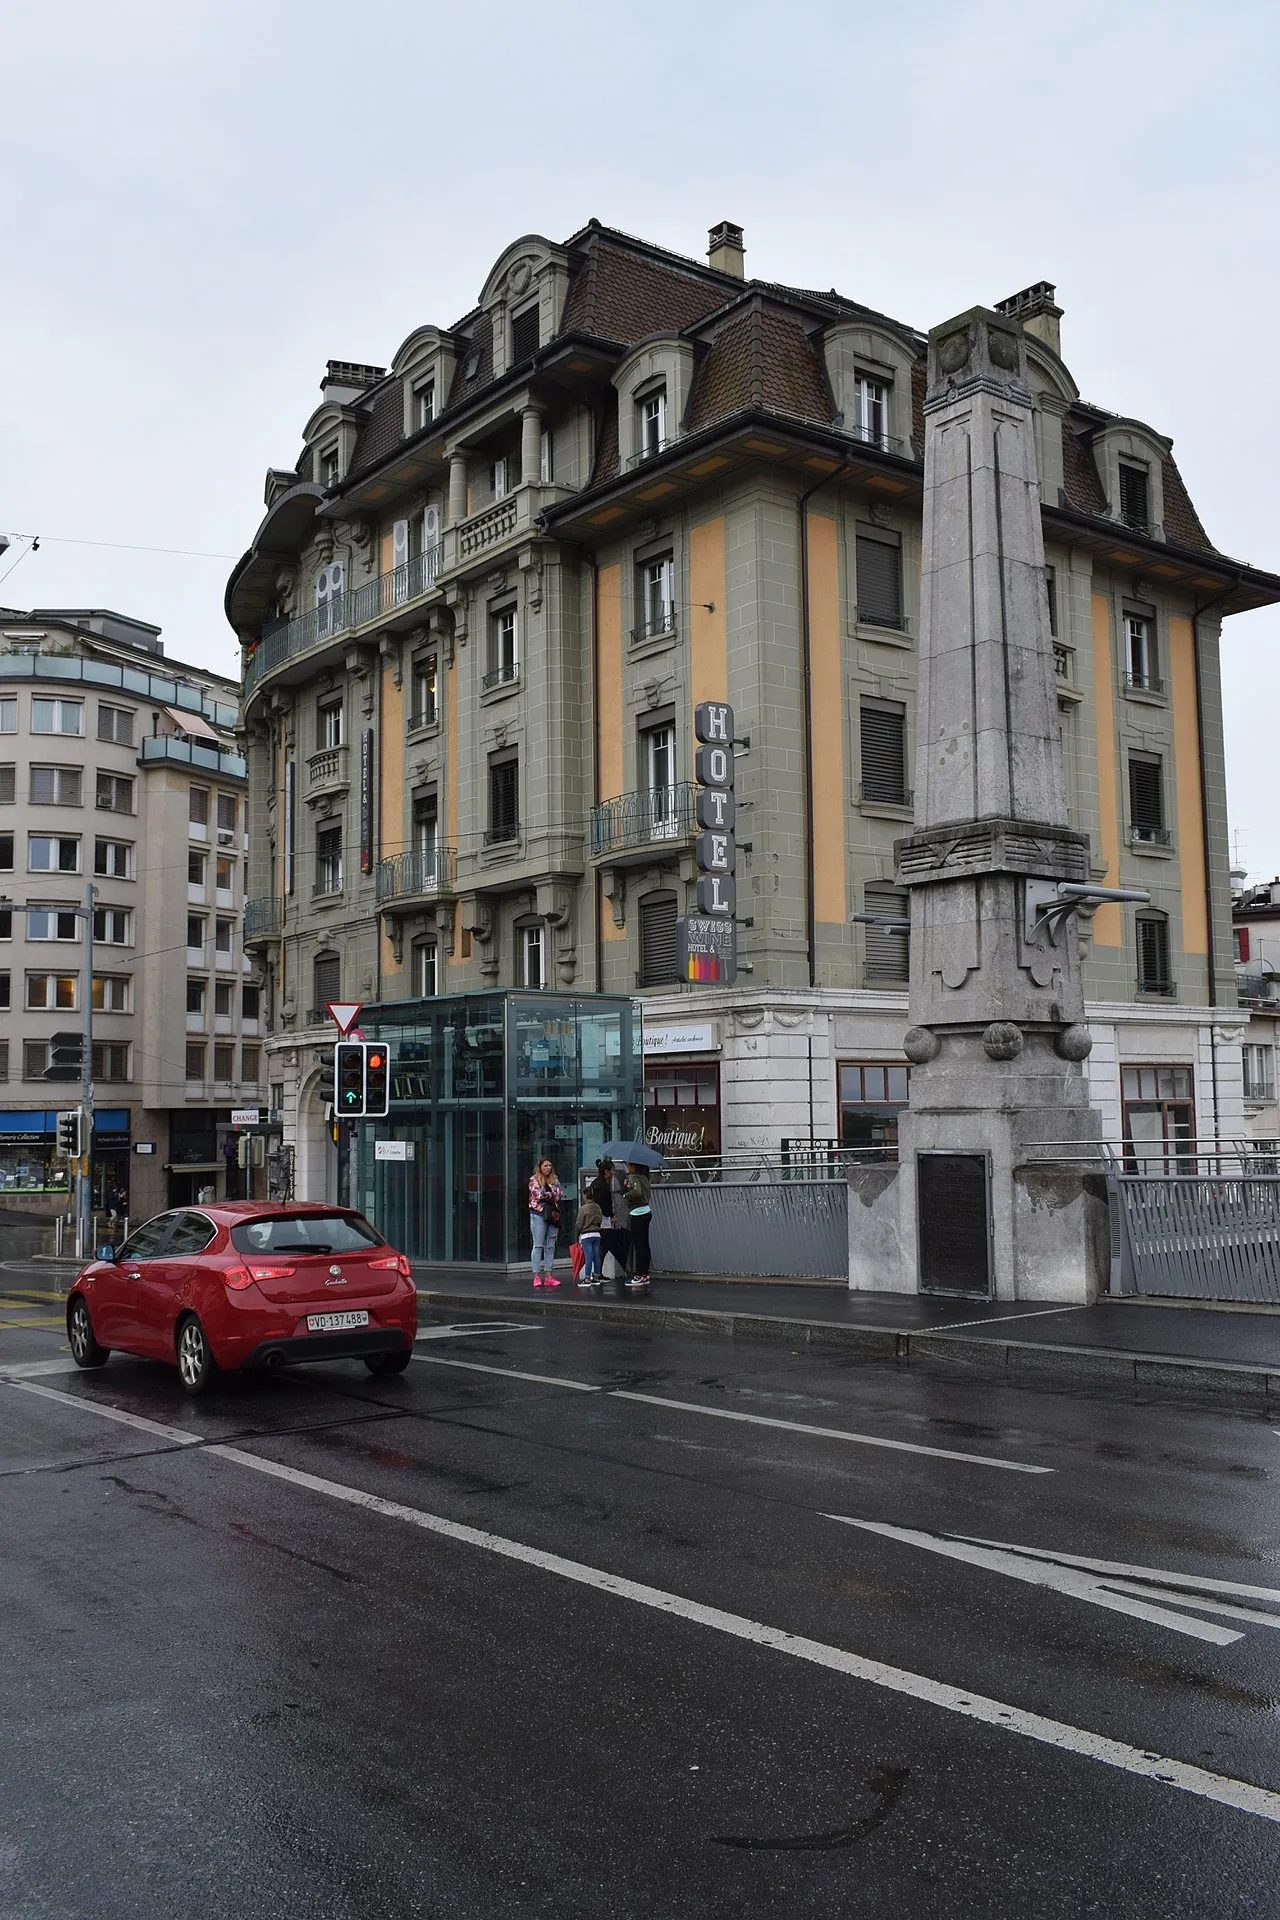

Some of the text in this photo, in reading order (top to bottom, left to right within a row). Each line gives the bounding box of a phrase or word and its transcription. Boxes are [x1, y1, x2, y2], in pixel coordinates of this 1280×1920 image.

[708, 706, 729, 911] HOTEL
[688, 919, 732, 934] SWISS
[688, 930, 732, 947] WINE
[687, 943, 708, 953] HOTEL
[709, 944, 716, 954] &
